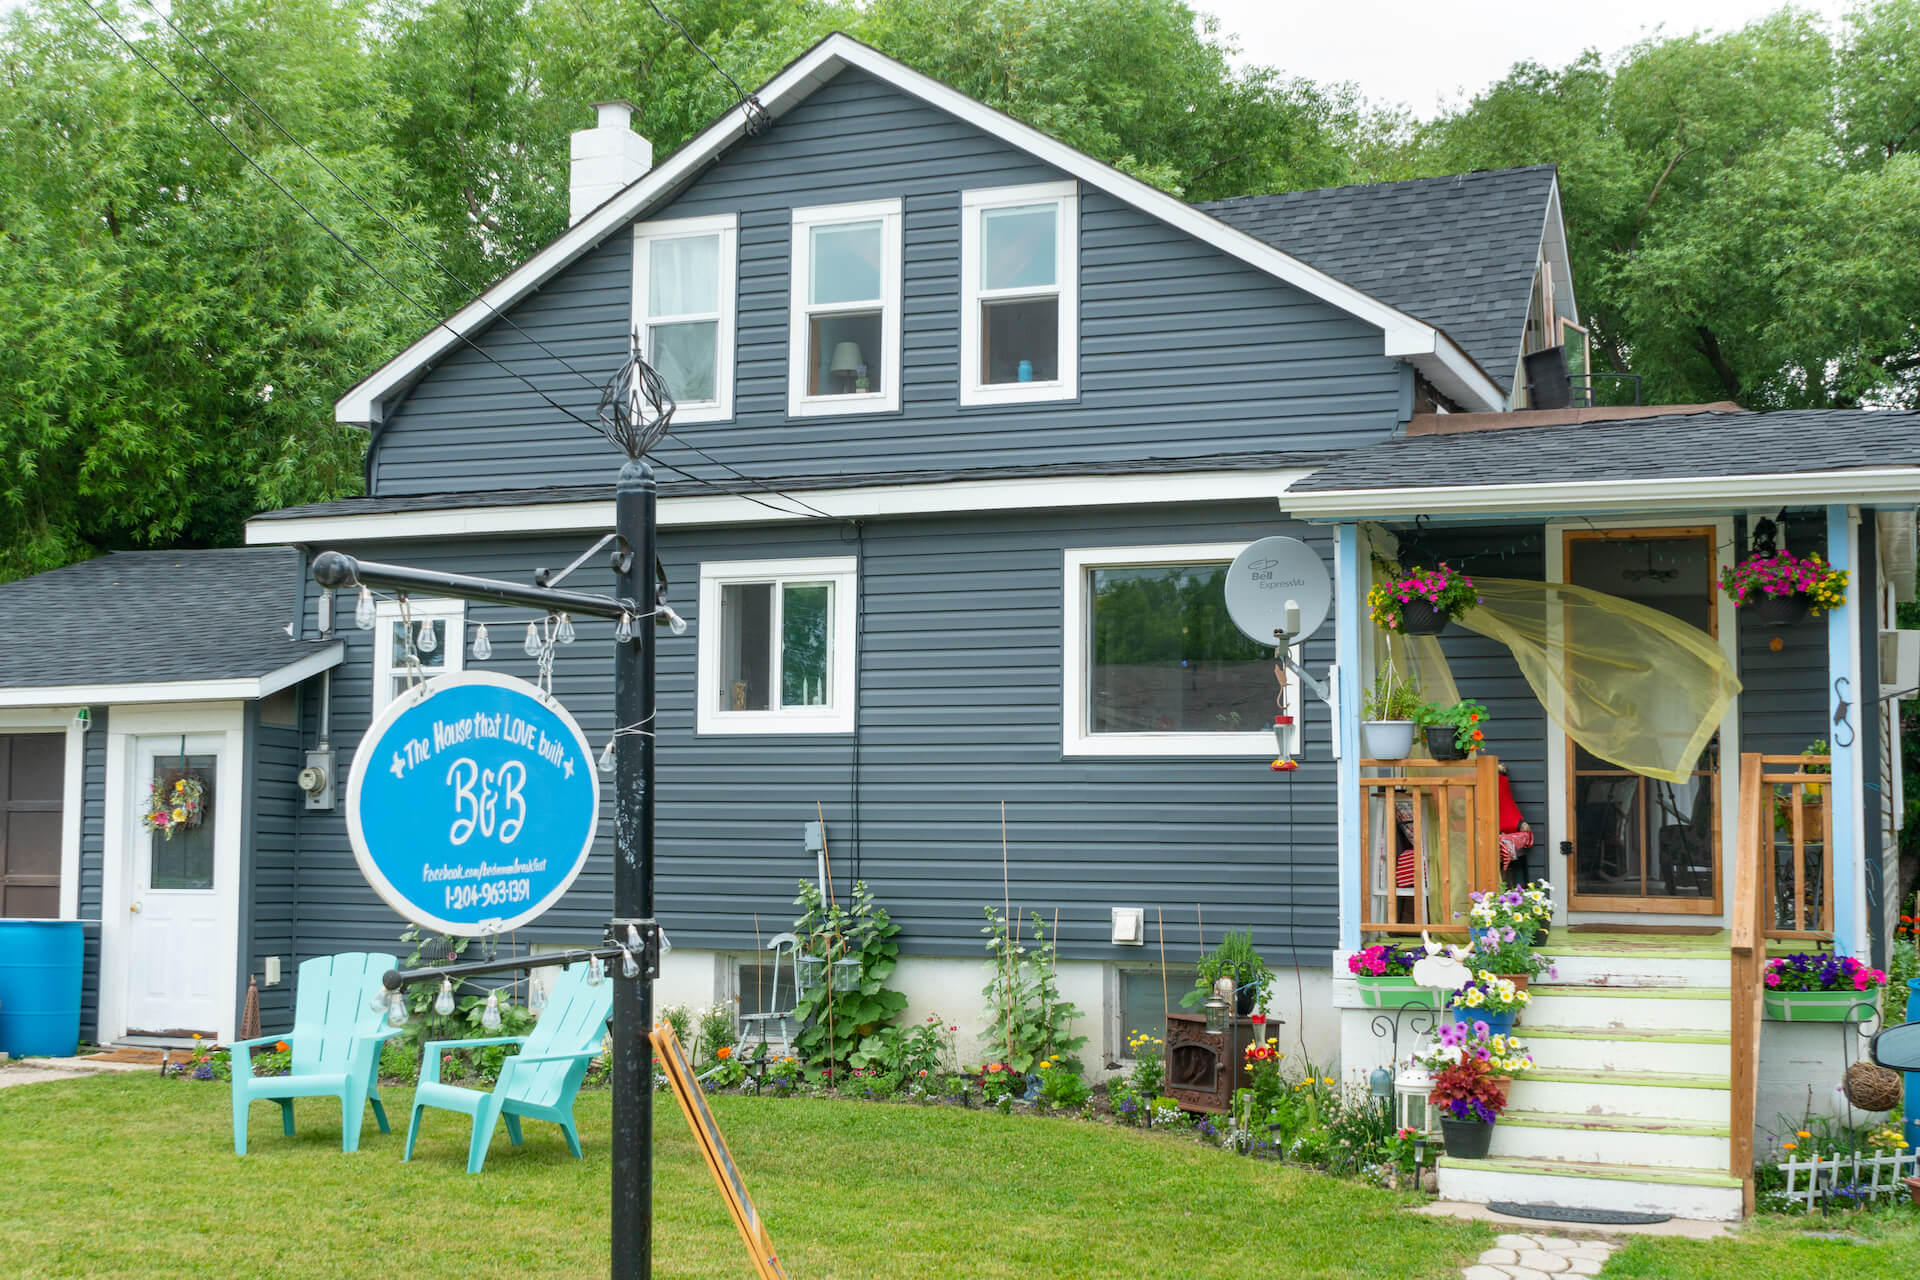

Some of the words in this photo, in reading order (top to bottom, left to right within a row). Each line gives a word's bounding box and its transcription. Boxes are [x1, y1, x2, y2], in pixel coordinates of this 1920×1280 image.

[1252, 571, 1273, 581] Bell
[1260, 579, 1305, 590] ExpressVu
[404, 738, 431, 770] The
[433, 719, 473, 754] House
[474, 711, 502, 739] that
[503, 713, 537, 750] LOVE
[538, 729, 565, 768] built
[446, 757, 527, 846] B&B
